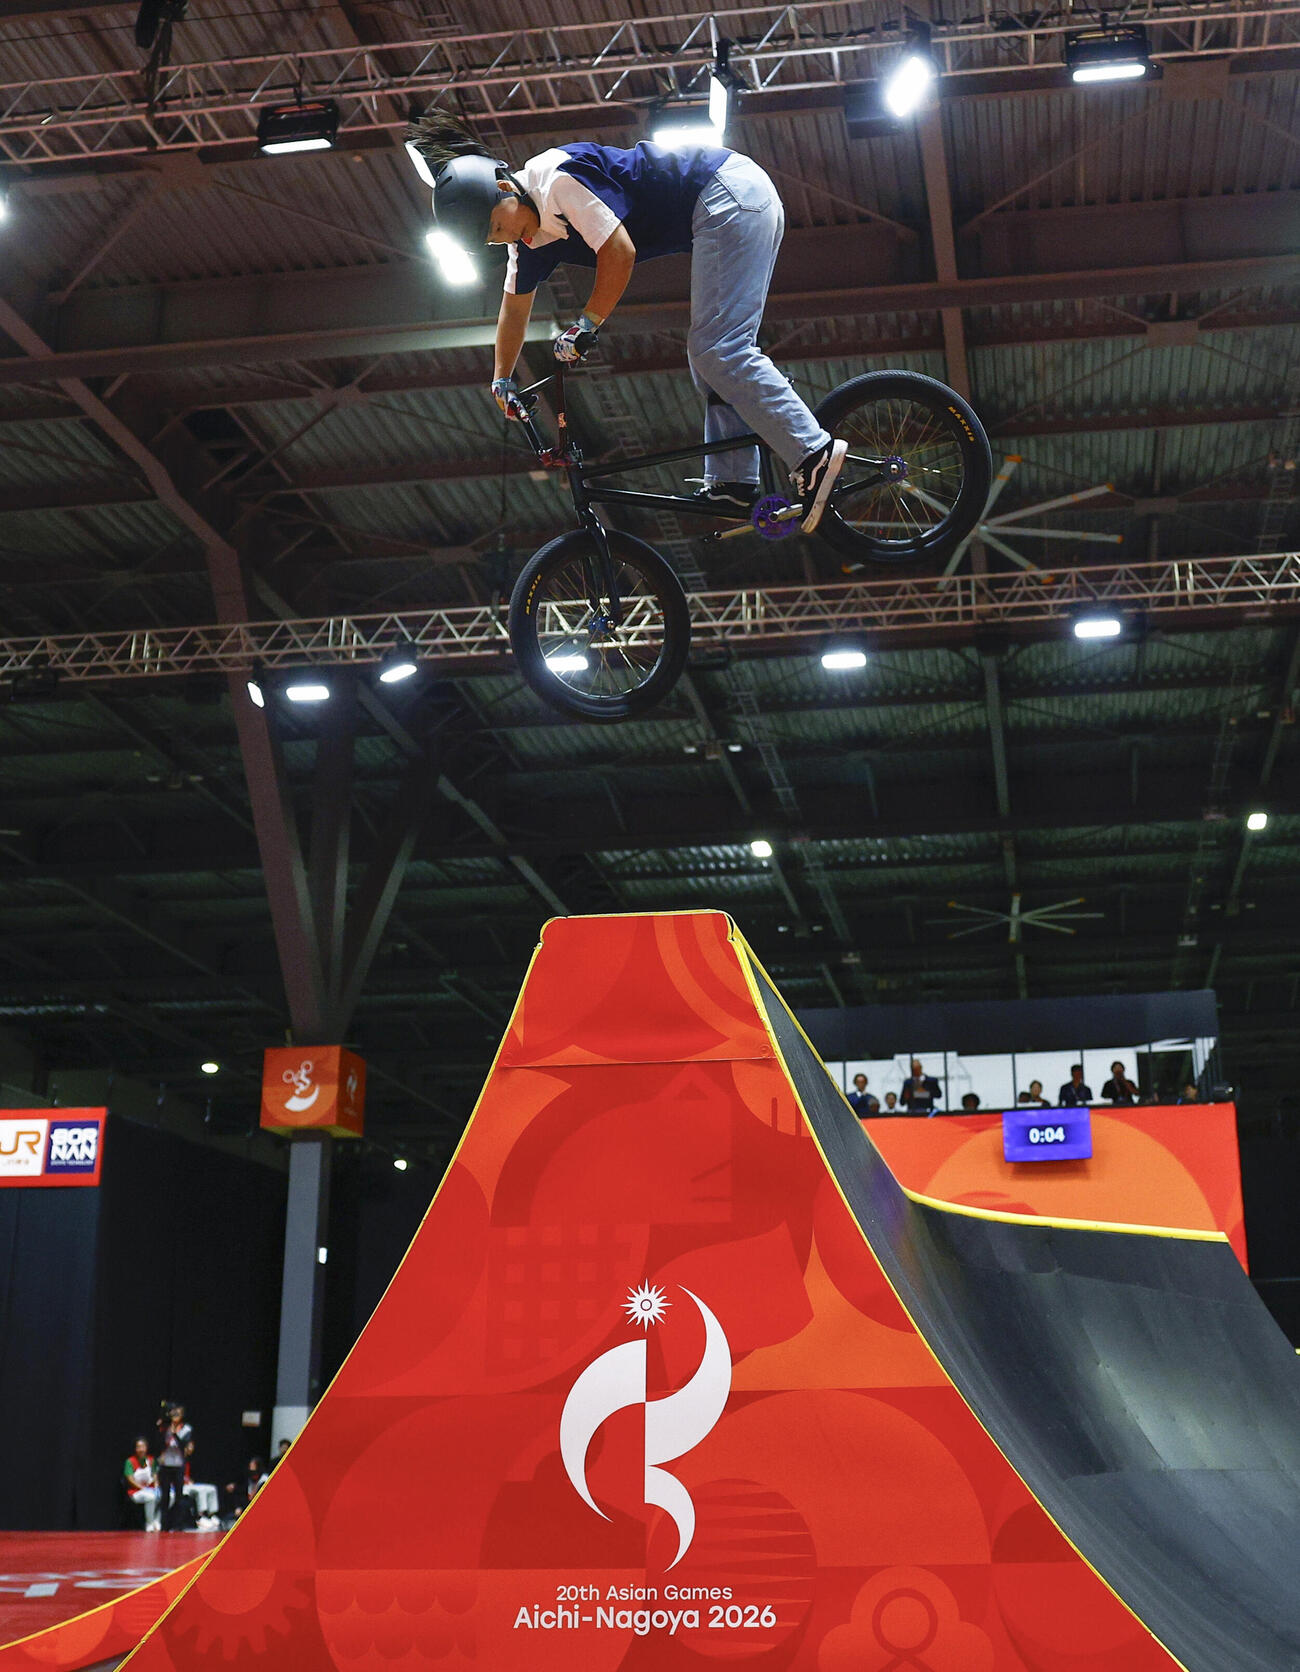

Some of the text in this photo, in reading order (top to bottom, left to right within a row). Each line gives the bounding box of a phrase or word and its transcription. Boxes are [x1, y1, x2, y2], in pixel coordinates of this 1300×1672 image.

[50, 1128, 98, 1145] BOR
[1029, 1127, 1065, 1144] 0:04
[50, 1145, 96, 1161] NAN
[556, 1584, 733, 1601] 20th Asian Games
[513, 1604, 777, 1636] Aichi-Nagoya 2026
